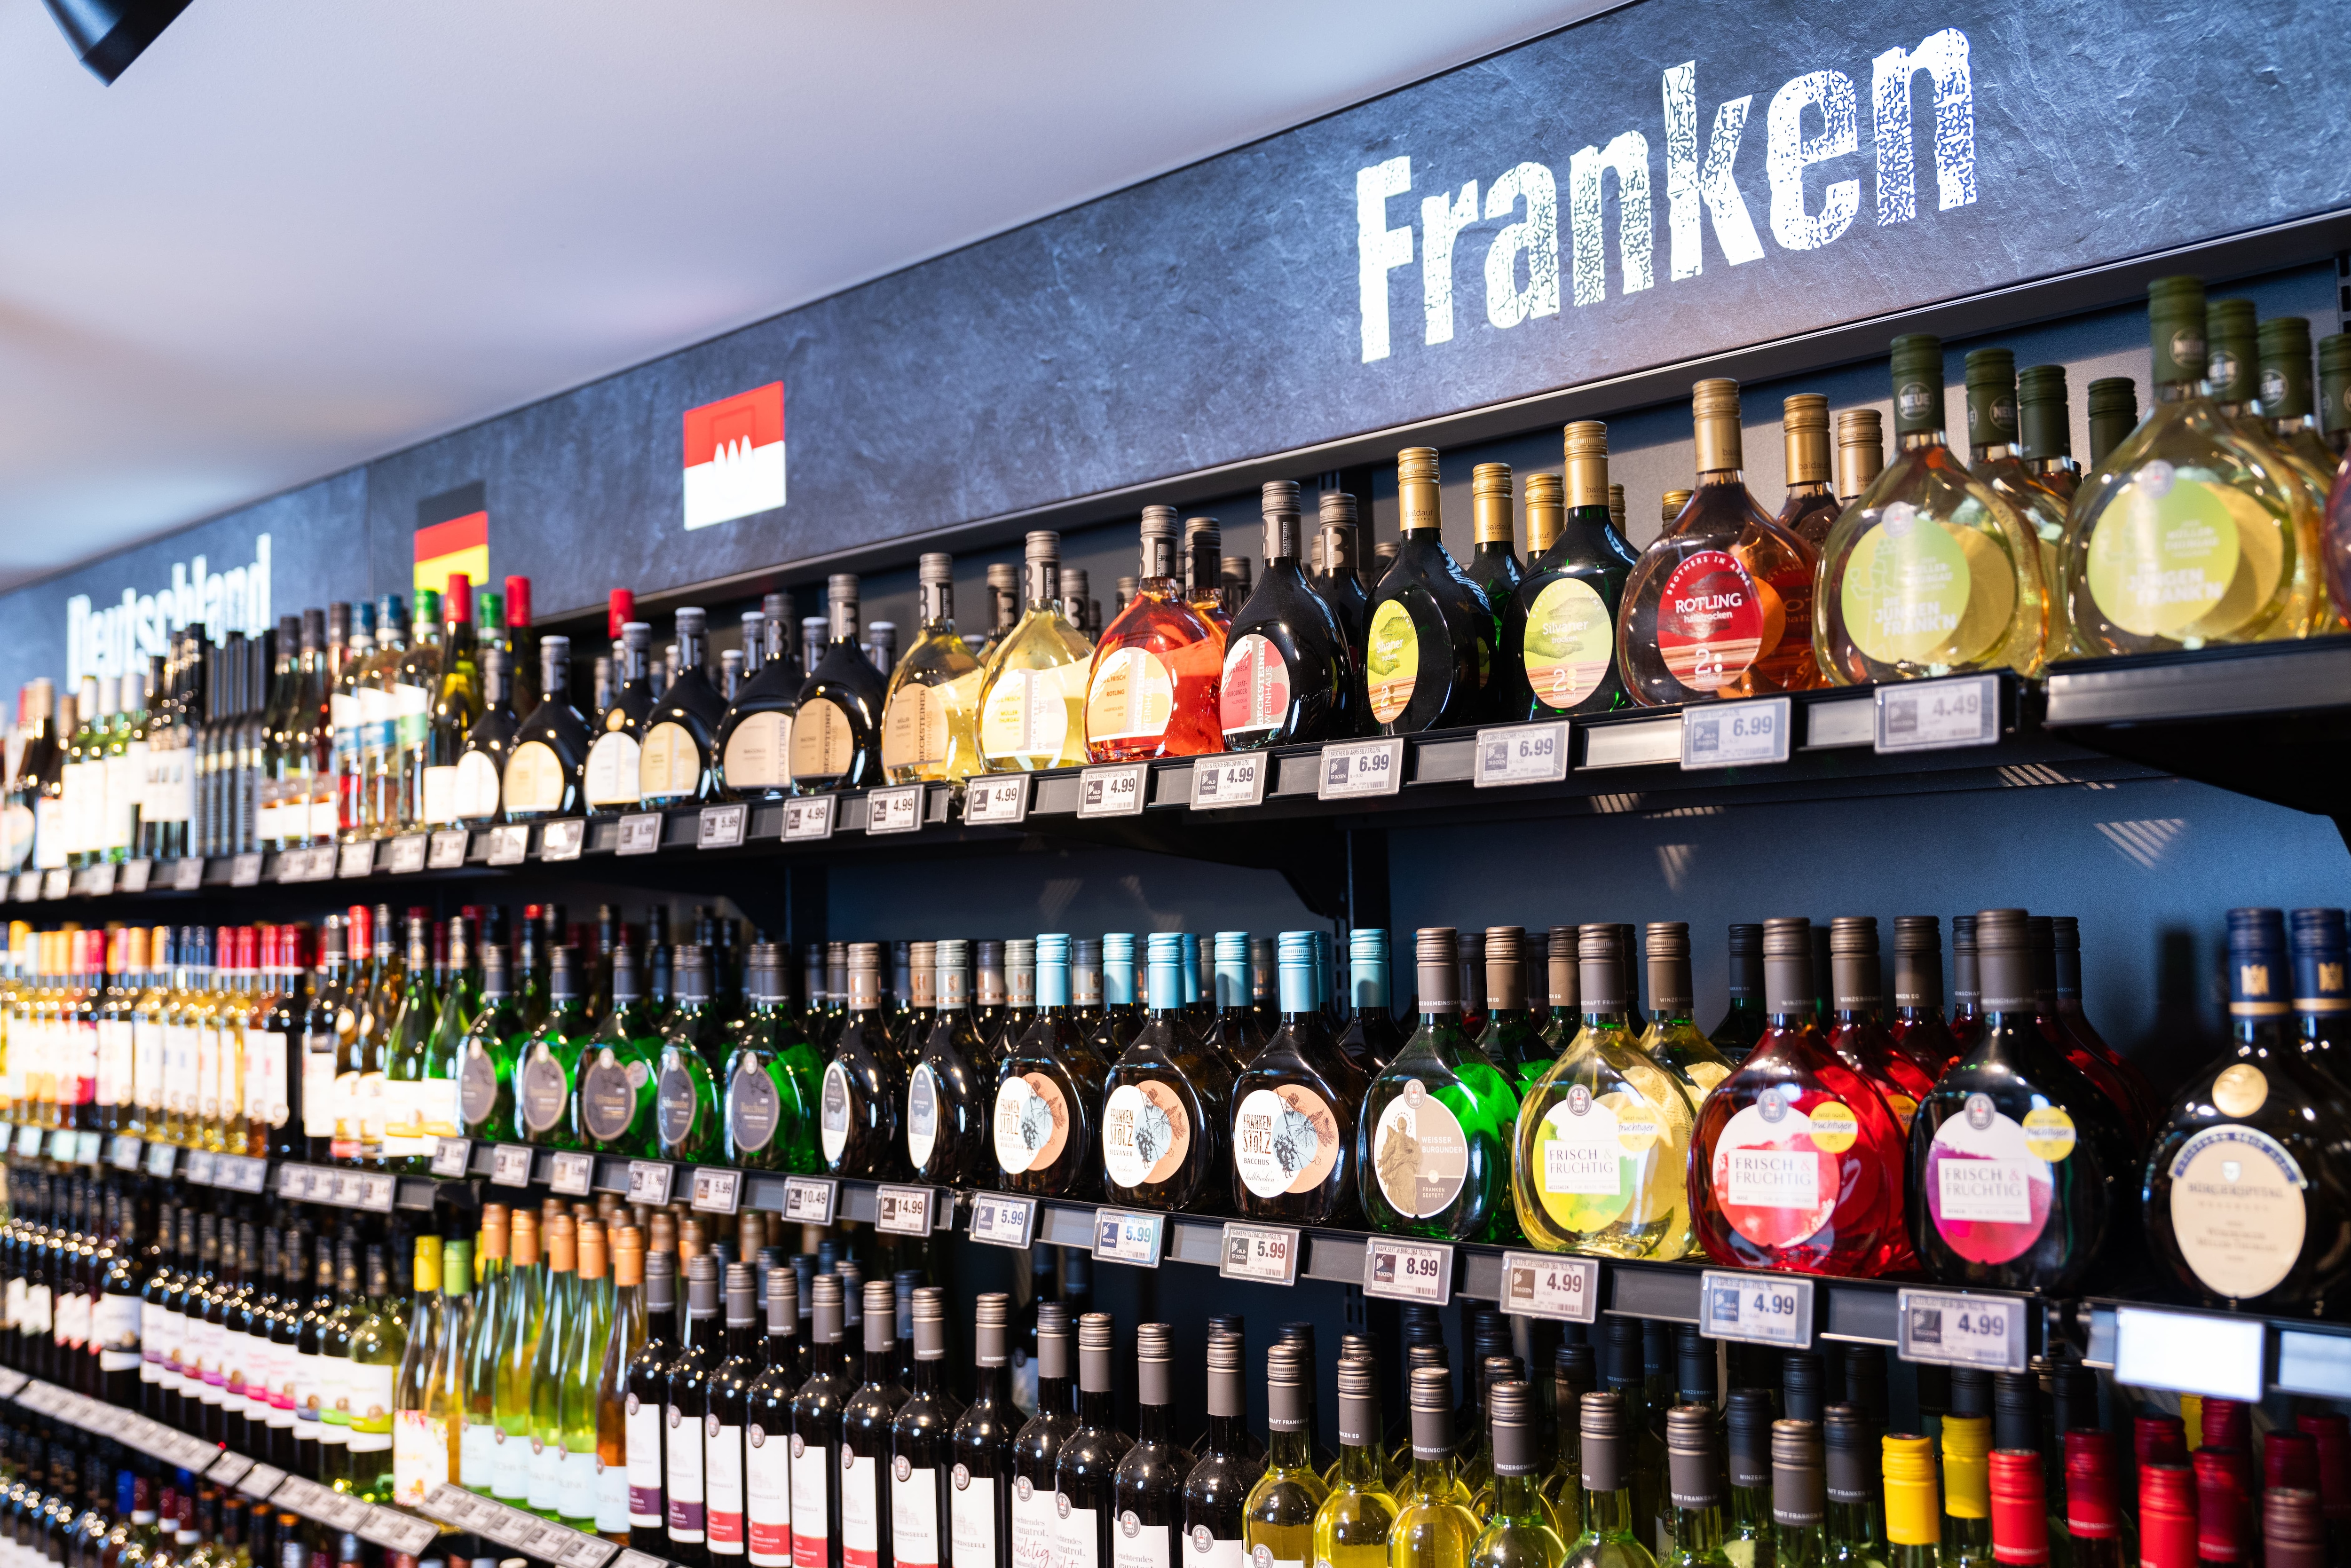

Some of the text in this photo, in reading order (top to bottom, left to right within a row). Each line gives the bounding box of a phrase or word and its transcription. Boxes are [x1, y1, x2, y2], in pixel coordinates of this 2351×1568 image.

[1357, 27, 1977, 363] Franken
[1900, 393, 1930, 408] NEUE
[1527, 532, 1549, 541] baldauf
[1667, 556, 1708, 595] BROTHERS
[1729, 563, 1751, 586] ARMS
[1532, 583, 1566, 618] BROTHERS
[1585, 589, 1602, 611] ARMS
[1675, 592, 1743, 614] ROTLING
[1684, 610, 1733, 623] halbtrocken
[1875, 601, 1940, 623] JUNGEN
[1371, 603, 1390, 638] BROTHERS
[1399, 610, 1412, 629] ARMS
[1543, 620, 1589, 635] Silvaner
[1377, 638, 1404, 654] Silvaner
[1552, 635, 1578, 644] trocken
[1257, 640, 1266, 725] BECKSTEINER
[1134, 654, 1146, 732] BECKSTEINER
[1227, 688, 1247, 697] BURGUNDER
[1142, 677, 1153, 731] WEINHAUS
[1932, 695, 1978, 717] 4.49
[1381, 708, 1394, 716] baldauf
[1733, 715, 1773, 736] 6.99
[1520, 738, 1553, 757] 6.99
[1359, 754, 1389, 772] 6.99
[1227, 767, 1254, 783] 4.99
[1111, 778, 1135, 793] 4.99
[995, 788, 1017, 801] 4.99
[894, 798, 913, 812] 4.99
[807, 807, 825, 819] 4.99
[1001, 1098, 1019, 1113] FRANKEN
[1111, 1108, 1133, 1123] FRANKEN
[1243, 1114, 1271, 1130] FRANKEN
[1000, 1112, 1019, 1135] STOLZ
[1618, 1122, 1655, 1134] fruchtiger
[1811, 1119, 1853, 1132] fruchtiger
[1110, 1124, 1133, 1146] STOLZ
[2025, 1126, 2069, 1139] fruchtiger
[1243, 1130, 1271, 1154] STOLZ
[1422, 1145, 1463, 1154] BURGUNDER
[1550, 1149, 1613, 1160] FRISCH &
[1550, 1161, 1613, 1174] FRUCHTIG
[1736, 1158, 1811, 1171] FRISCH &
[1245, 1171, 1275, 1182] halbtrocken
[1736, 1172, 1811, 1185] FRUCHTIG
[1945, 1168, 2020, 1181] FRISCH &
[715, 1181, 731, 1194] 5.99
[1945, 1182, 2021, 1197] FRUCHTIG
[803, 1190, 826, 1204] 10.49
[898, 1200, 923, 1214] 14.99
[1001, 1209, 1024, 1225] 5.99
[1126, 1225, 1151, 1243] 5.99
[1257, 1241, 1286, 1259] 5.99
[1406, 1257, 1438, 1276] 8.99
[1547, 1272, 1582, 1292] 4.99
[1753, 1293, 1794, 1315] 4.99
[1958, 1313, 2004, 1336] 4.99
